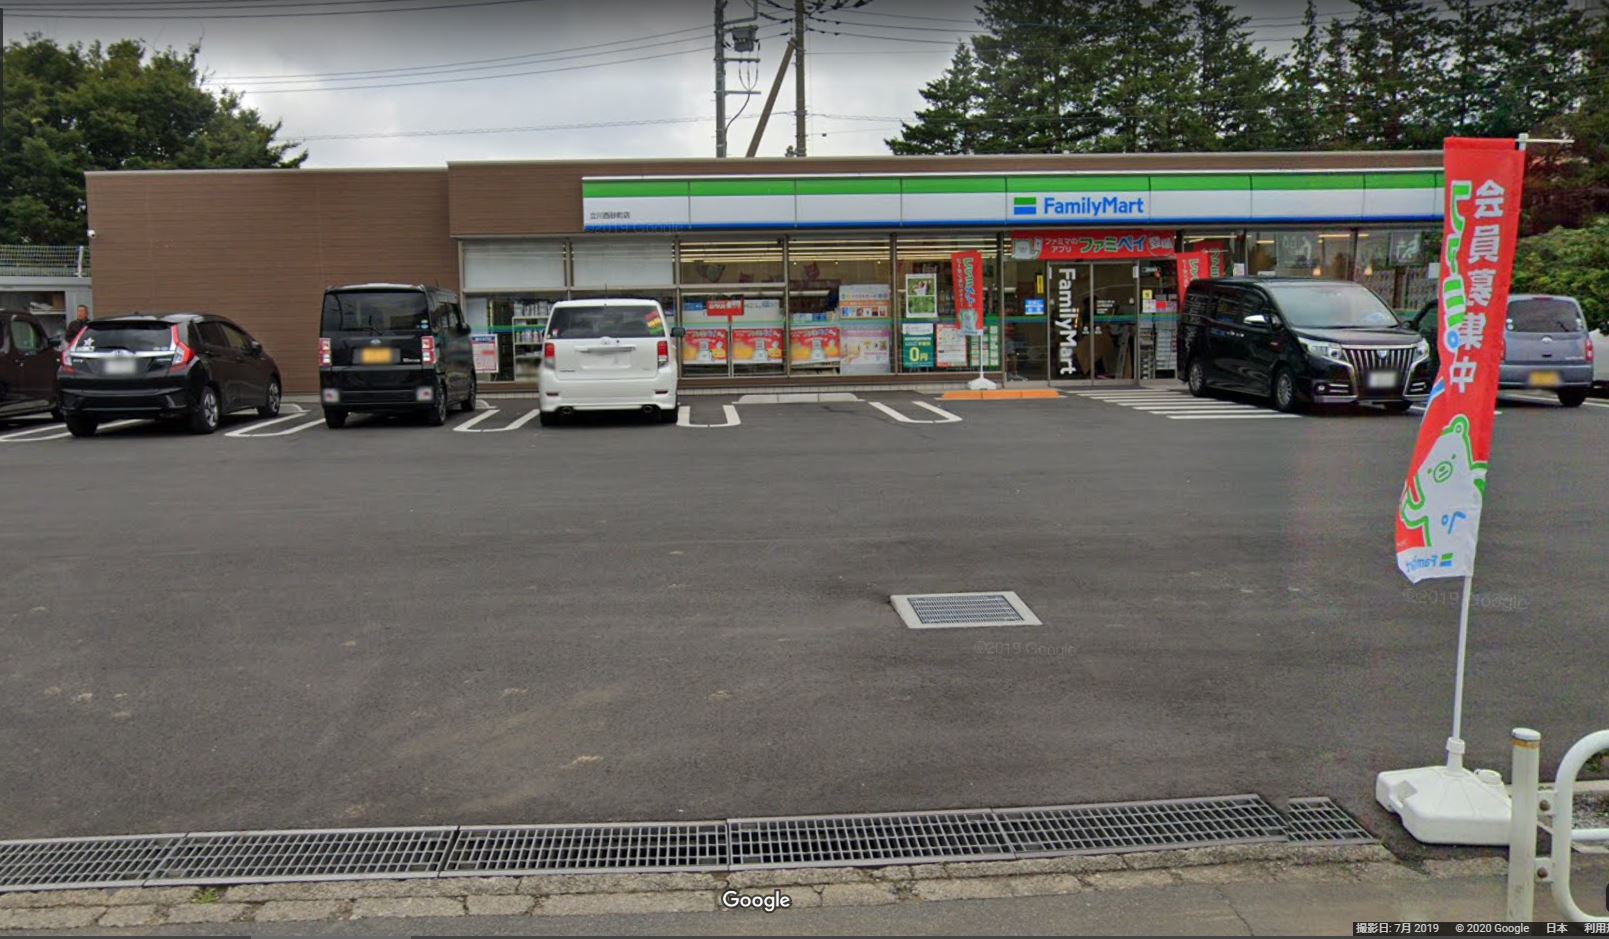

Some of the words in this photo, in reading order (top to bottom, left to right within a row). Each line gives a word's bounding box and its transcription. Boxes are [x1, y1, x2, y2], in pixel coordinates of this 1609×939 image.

[1044, 197, 1144, 216] FamilyMart
[1051, 245, 1073, 254] アプリ
[1079, 236, 1147, 254] ファミペイ
[1054, 268, 1078, 375] FamilyMart
